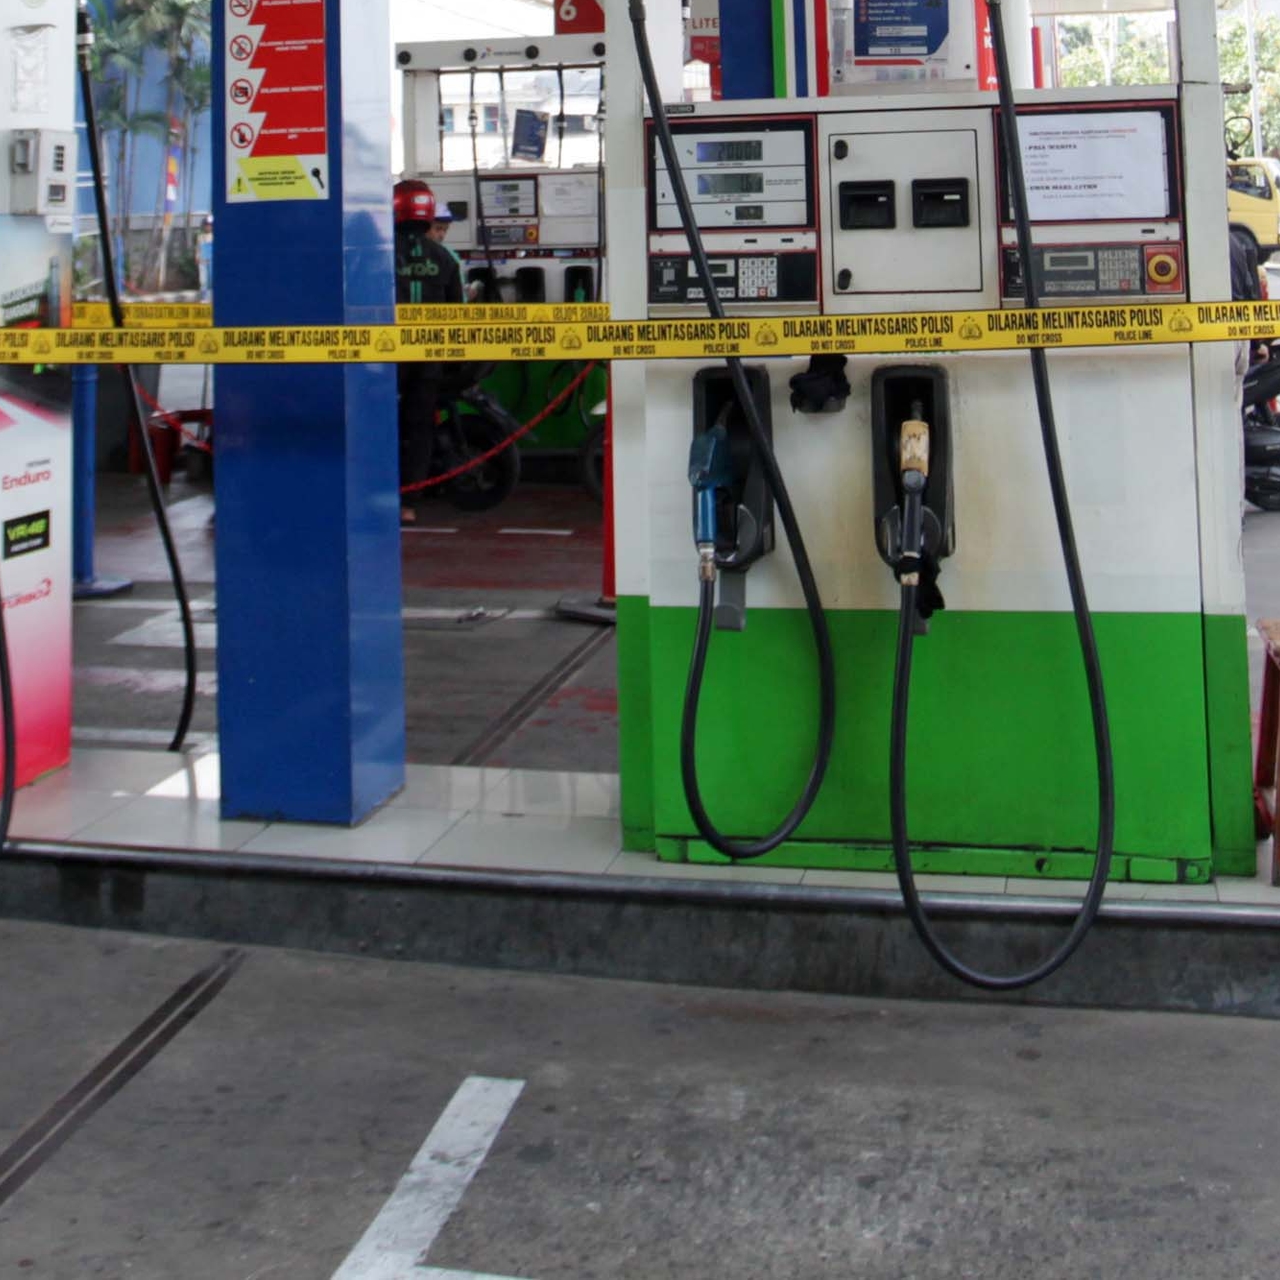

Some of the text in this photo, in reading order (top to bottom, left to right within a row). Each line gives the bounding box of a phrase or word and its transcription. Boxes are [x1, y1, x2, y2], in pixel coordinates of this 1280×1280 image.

[987, 312, 1038, 331] DILARANG
[1130, 308, 1162, 326] POLISI
[1198, 305, 1249, 323] DILARANG
[400, 329, 444, 345] DILARANG
[526, 327, 555, 343] POLISI
[587, 325, 633, 342] DILARANG
[719, 322, 750, 339] POLISI
[783, 320, 832, 338] DILARANG
[921, 316, 953, 333] POLISI
[2, 470, 51, 490] Enduro
